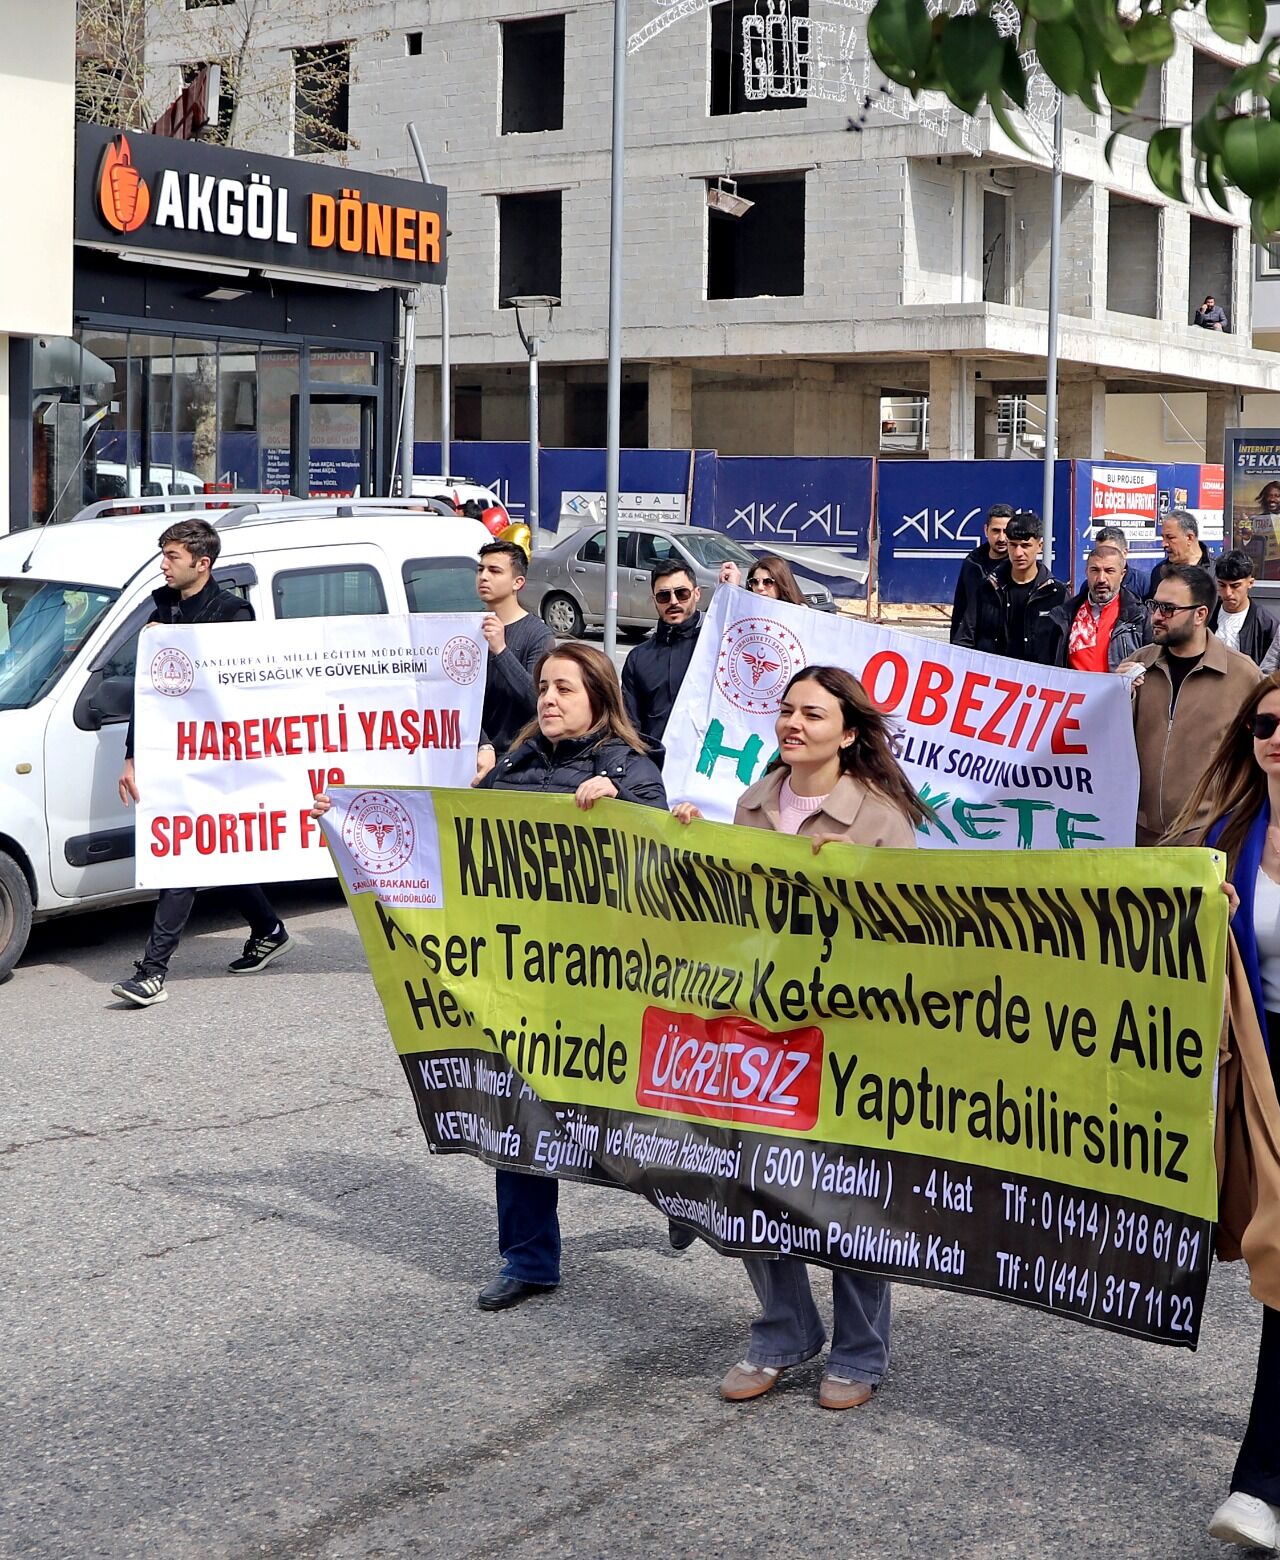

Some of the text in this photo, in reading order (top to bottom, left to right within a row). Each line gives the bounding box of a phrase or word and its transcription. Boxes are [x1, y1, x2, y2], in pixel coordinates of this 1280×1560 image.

[155, 168, 440, 264] AKGÖL DÖNER
[1238, 443, 1274, 454] İNTERNET
[1107, 474, 1144, 484] BU PROJEDE
[726, 501, 858, 542] AKÇAL
[194, 655, 261, 669] ŞANLIURFA
[284, 652, 318, 663] MİLLİ
[323, 649, 366, 660] EĞİTİM
[371, 646, 441, 658] MÜDÜRLÜĞÜ
[218, 659, 428, 685] İŞYERİ SAĞLIK VE GÜVENLİK BİRİMİ
[861, 649, 1088, 755] OBEZİTE
[176, 704, 461, 761] HAREKETLİ YAŞAM
[944, 750, 1094, 795] SORUNUDUR
[150, 802, 287, 858] SPORTİF
[380, 878, 430, 889] BAKANLIĞI
[454, 816, 633, 915] KANSERDEN
[633, 833, 759, 929] KORKMA
[823, 876, 1086, 961] KALMAKTAN
[1080, 886, 1207, 984] KORK
[496, 923, 742, 1011] Taramalarınızı
[750, 956, 1030, 1044] Ketemlerde
[1045, 1000, 1097, 1058] ve
[1110, 999, 1204, 1079] Aile
[651, 1024, 811, 1106] ÜCRETSİZ
[828, 1051, 1189, 1183] Yaptırabilirsiniz
[418, 1057, 472, 1090] KETEM
[606, 1127, 621, 1155] ve
[622, 1122, 679, 1168] Araştırma
[676, 1132, 743, 1179] Hastanesi
[811, 1148, 880, 1199] Yataklı
[942, 1170, 975, 1213] kat
[1113, 1208, 1148, 1255] 318
[1152, 1217, 1173, 1262] 61
[1176, 1225, 1201, 1272] 61
[751, 1208, 820, 1254] Doğum
[826, 1220, 920, 1268] Poliklinik
[925, 1232, 966, 1277] Katı
[1102, 1272, 1141, 1320] 317
[1145, 1287, 1162, 1328] 11
[1170, 1294, 1193, 1333] 22
